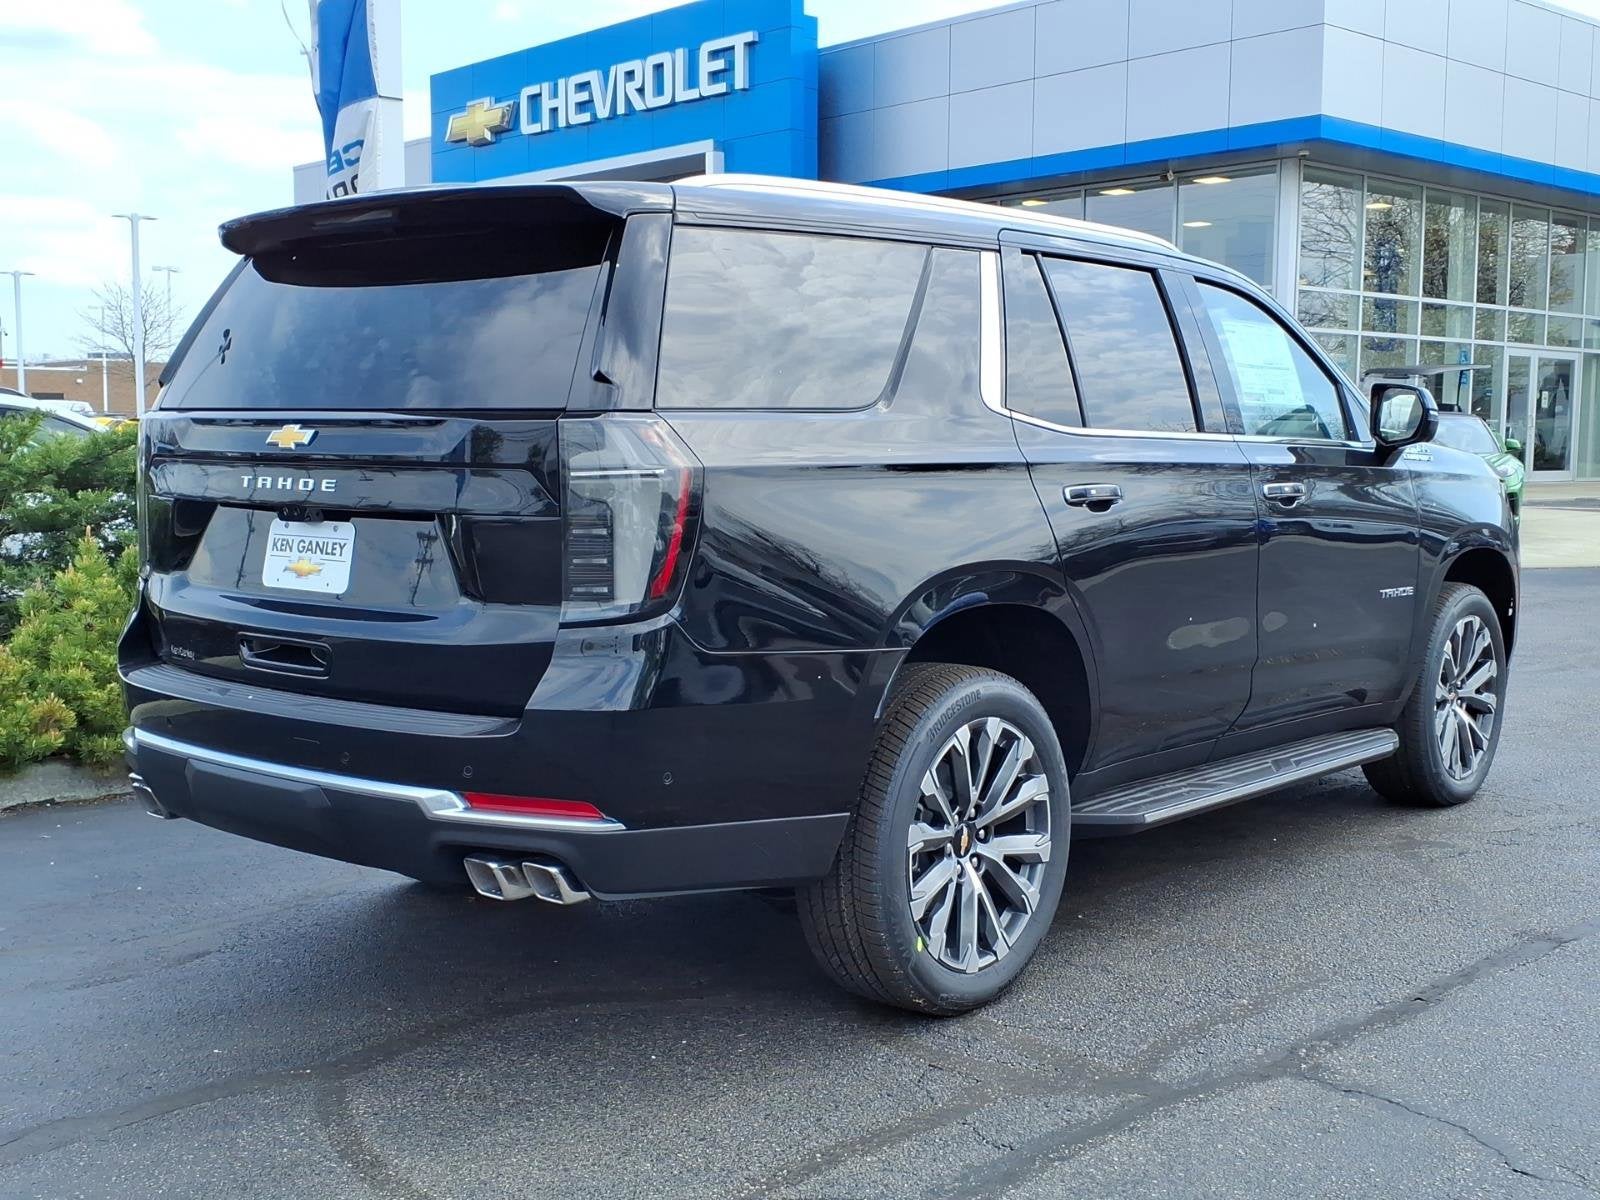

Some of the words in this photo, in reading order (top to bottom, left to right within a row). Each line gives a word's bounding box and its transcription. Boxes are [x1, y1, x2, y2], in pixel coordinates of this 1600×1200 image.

[519, 30, 759, 135] CHEVROLET
[240, 475, 337, 492] TAHOE
[271, 537, 294, 553] KEN
[296, 539, 347, 557] GANLEY
[1379, 586, 1414, 599] TAHOE
[926, 688, 983, 742] BRIDGESTONE
